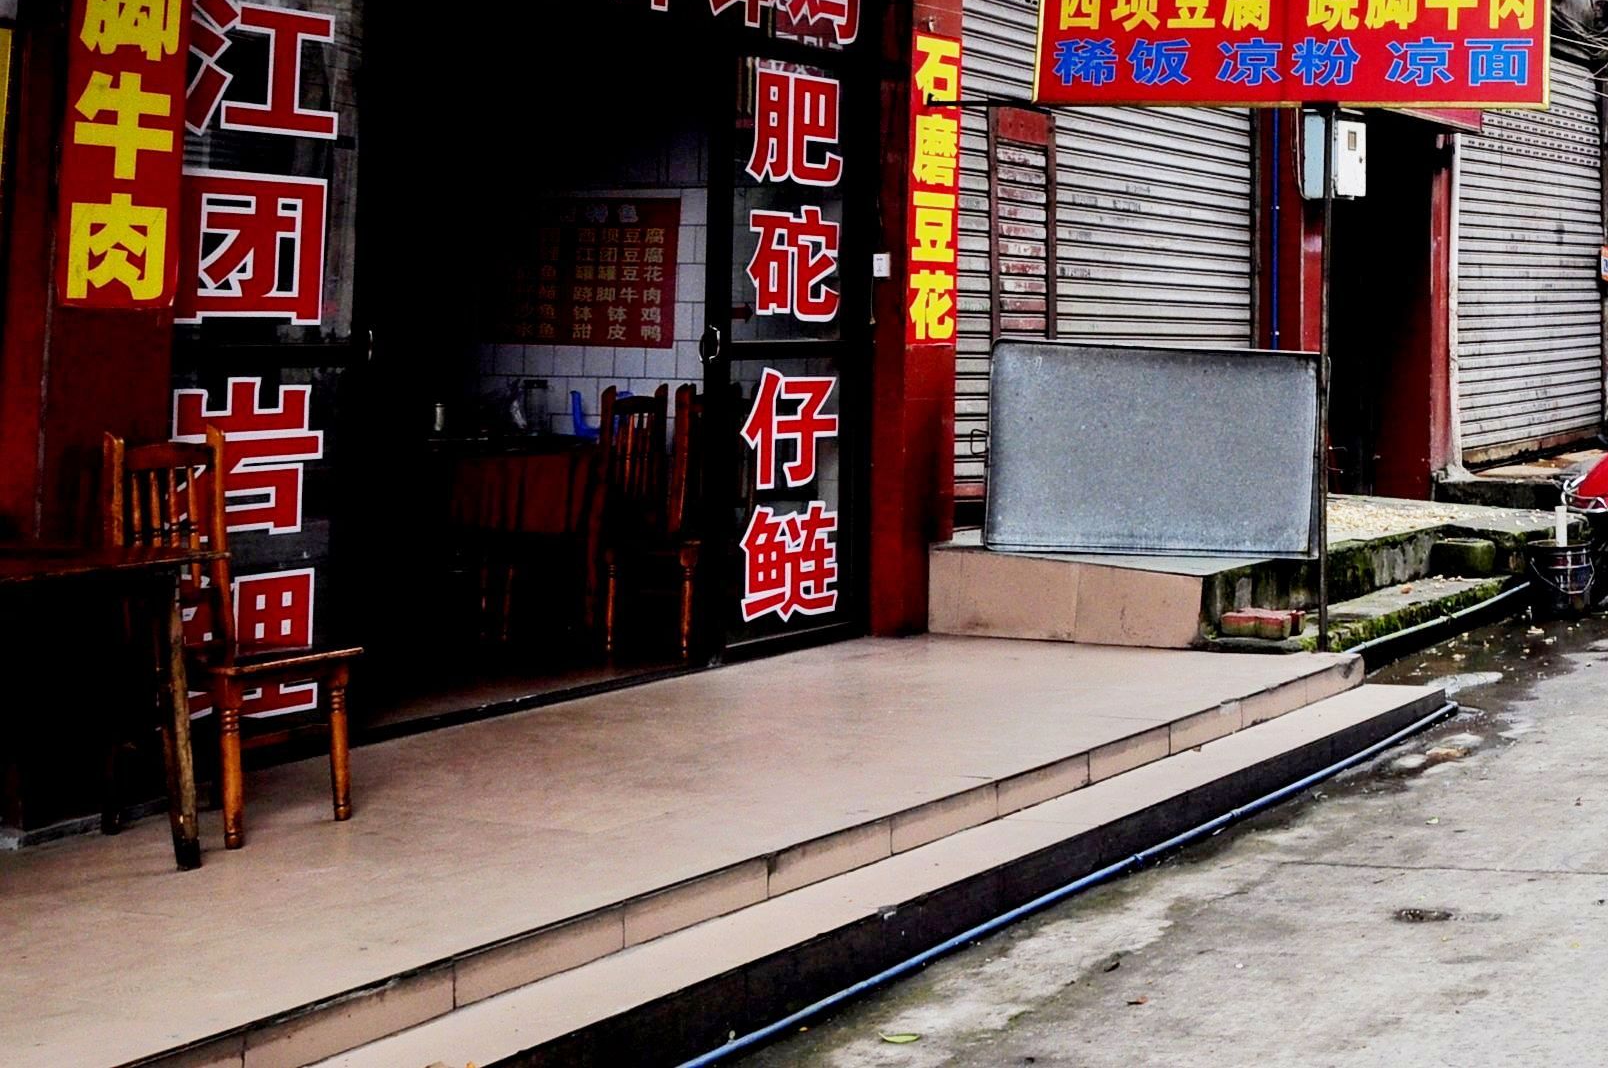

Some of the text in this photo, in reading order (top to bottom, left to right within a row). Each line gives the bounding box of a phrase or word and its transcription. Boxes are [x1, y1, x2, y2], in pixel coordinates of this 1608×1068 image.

[908, 35, 961, 341] 石磨豆花
[1053, 35, 1534, 87] 稀饭 凉粉 凉面
[746, 68, 843, 322] 肥砣
[741, 367, 838, 622] 仔鲢
